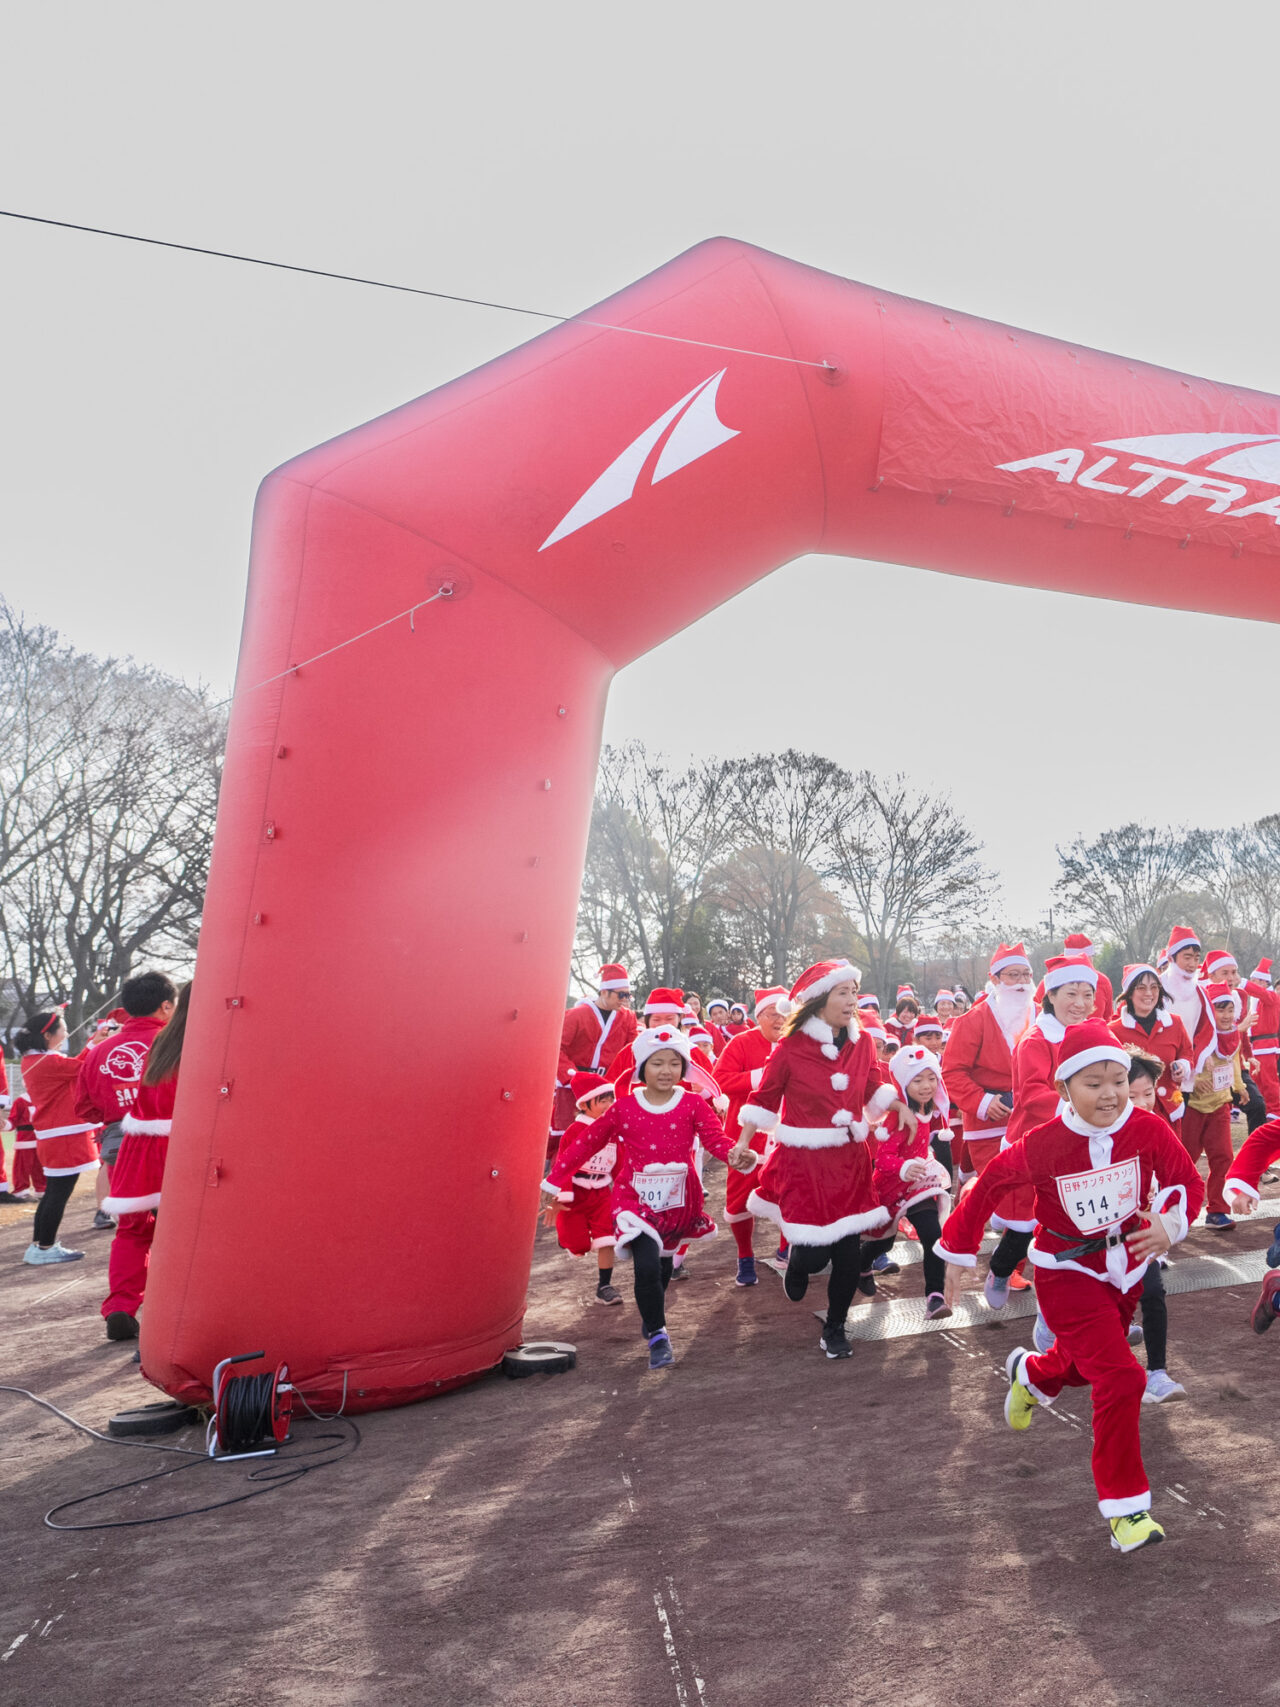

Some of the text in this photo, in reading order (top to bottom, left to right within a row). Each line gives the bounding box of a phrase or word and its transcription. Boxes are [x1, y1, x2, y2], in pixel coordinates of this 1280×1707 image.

[1064, 1167, 1133, 1193] 日野サンタマラソン
[640, 1191, 662, 1201] 201
[1076, 1195, 1109, 1217] 514
